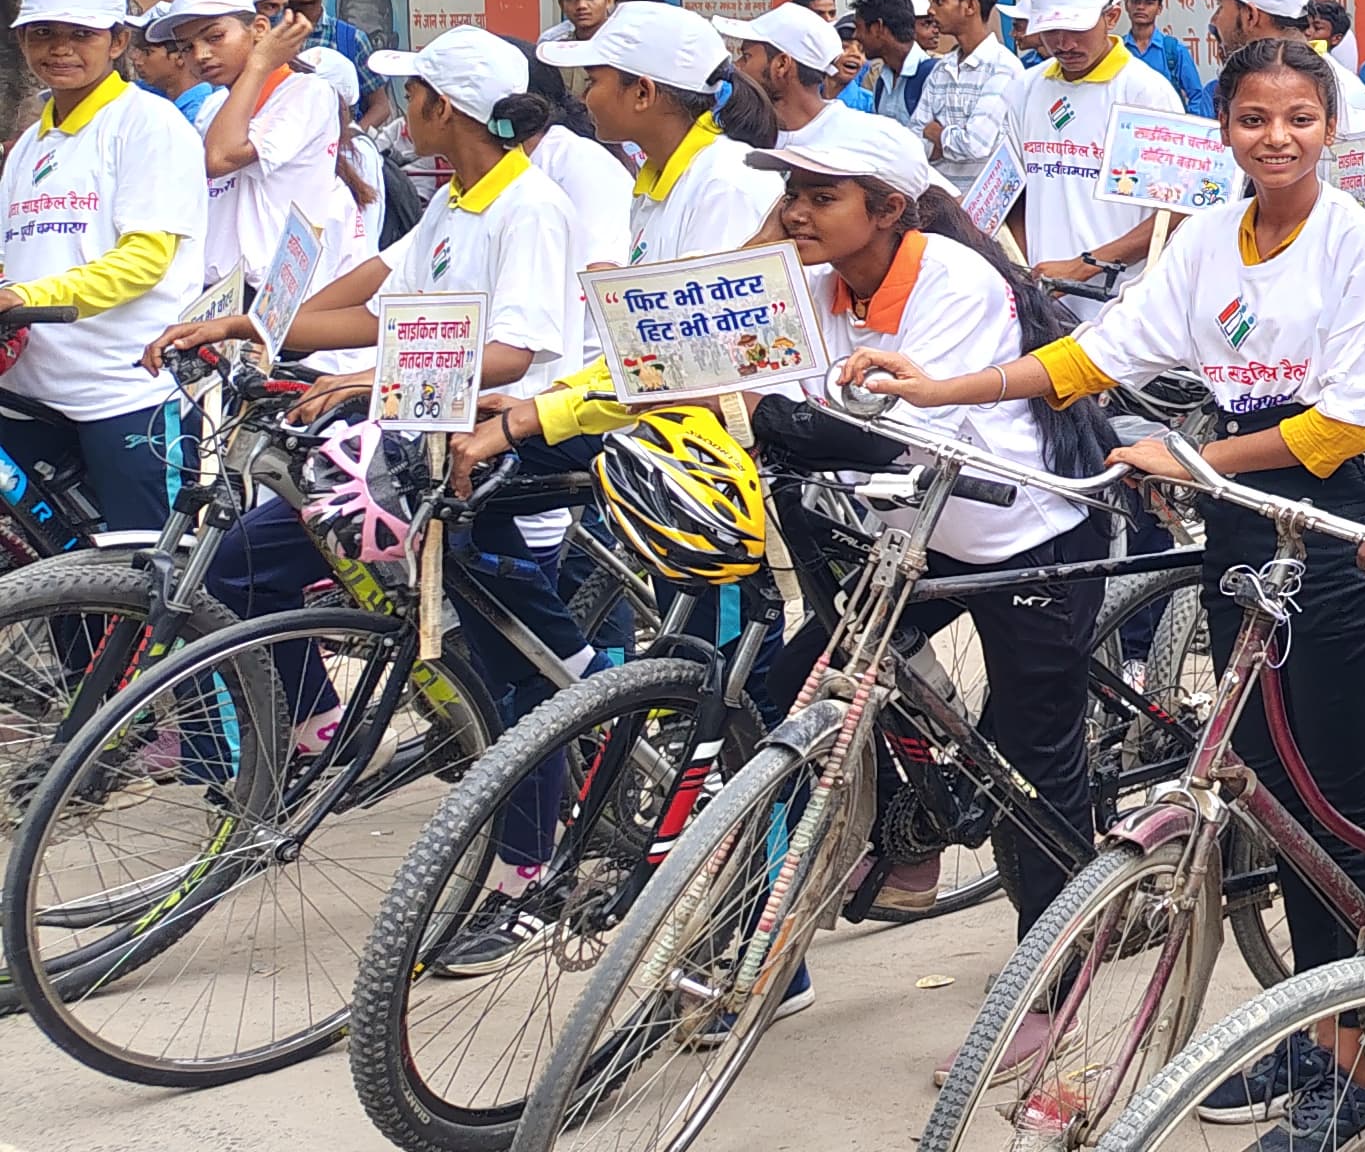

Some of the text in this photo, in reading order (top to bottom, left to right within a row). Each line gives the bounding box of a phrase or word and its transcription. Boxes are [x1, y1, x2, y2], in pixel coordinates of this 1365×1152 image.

[68, 191, 99, 211] रैली
[605, 275, 764, 314] “फिट भी वोटर
[636, 302, 786, 344] हिट भी वोटर”
